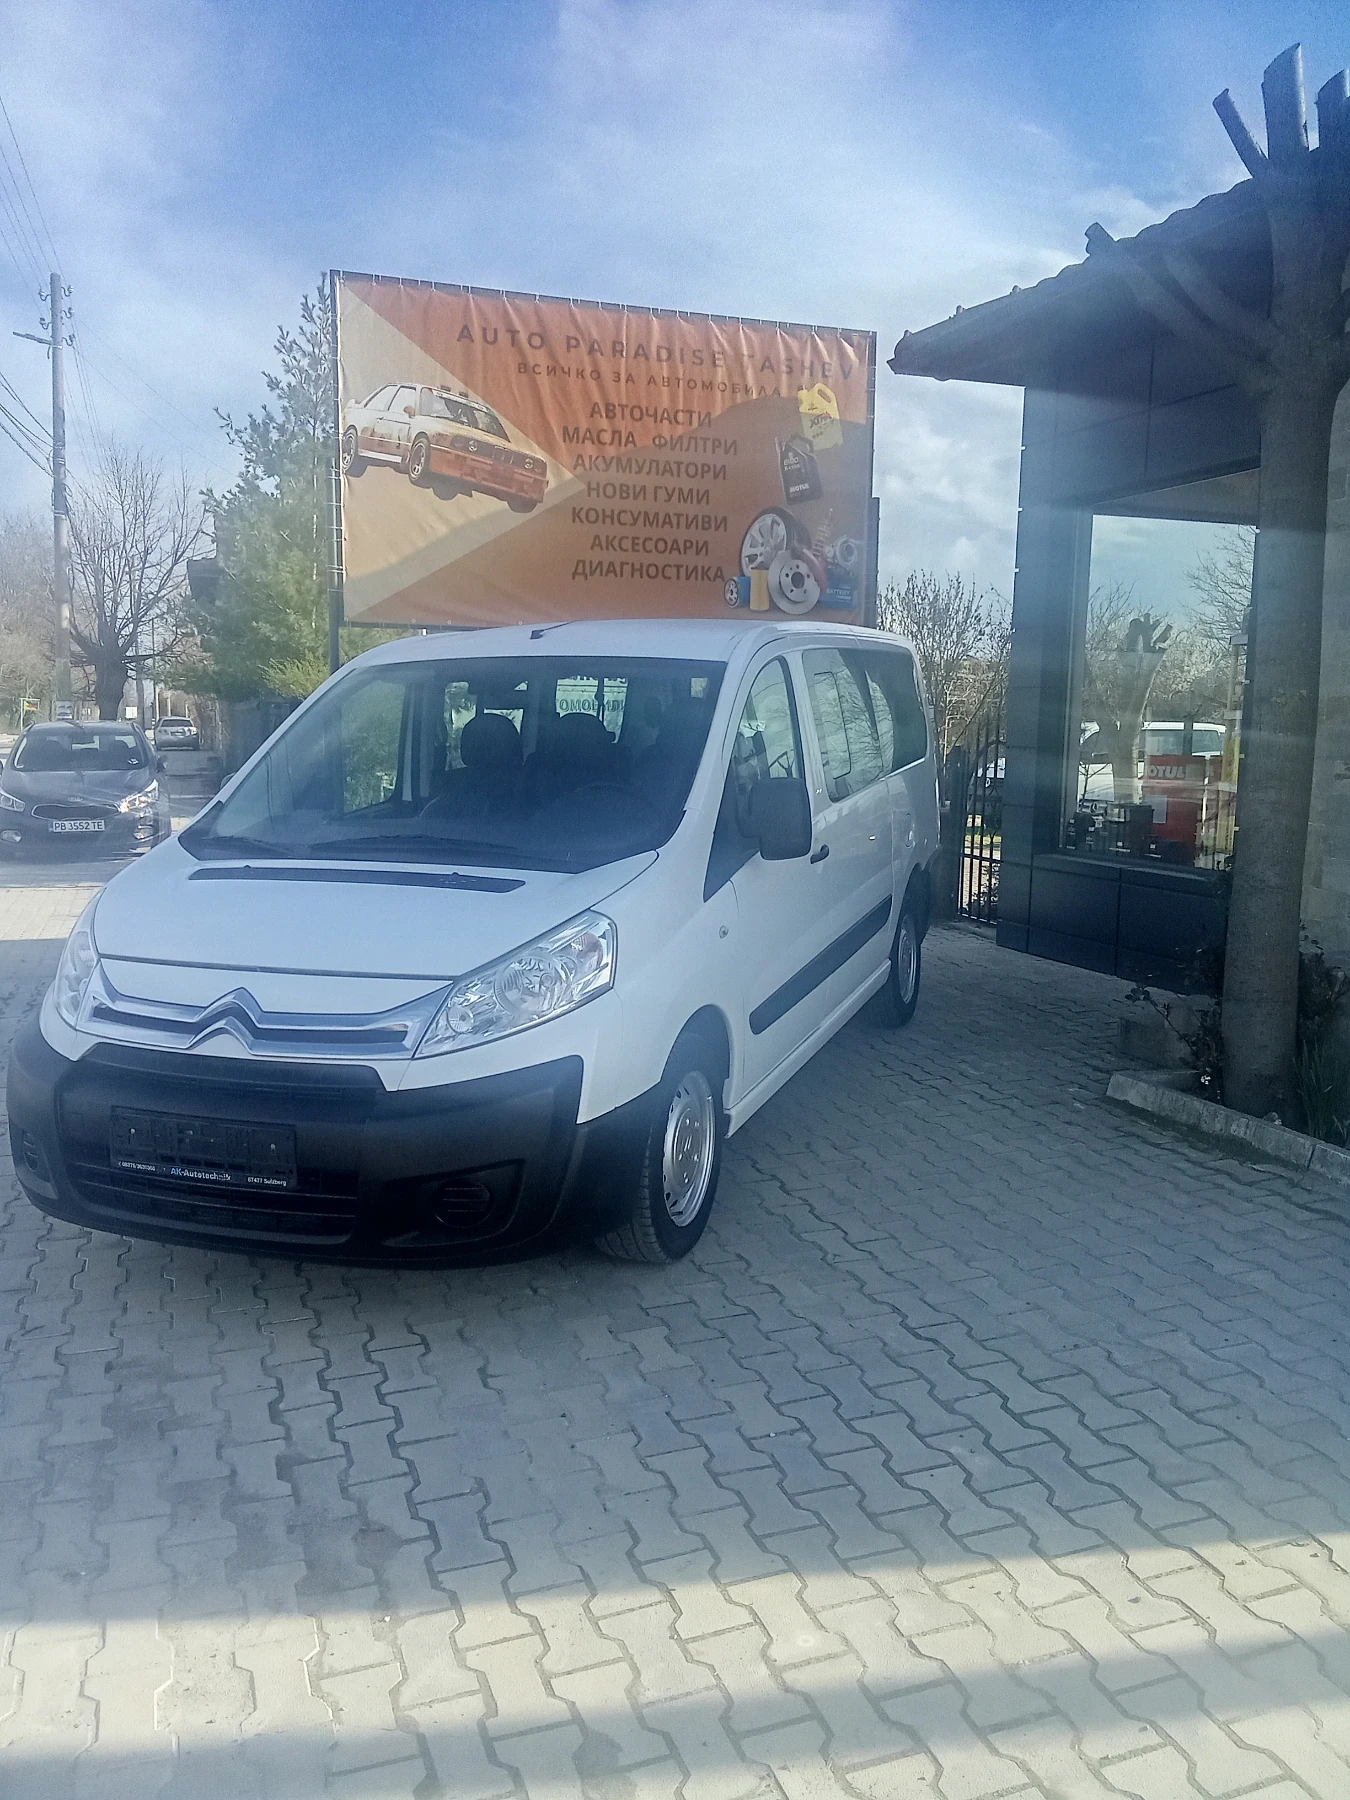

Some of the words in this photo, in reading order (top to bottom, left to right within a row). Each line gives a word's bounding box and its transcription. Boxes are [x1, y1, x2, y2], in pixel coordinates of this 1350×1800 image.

[457, 324, 545, 350] AUTO
[566, 335, 725, 368] PARADISE
[517, 362, 601, 382] ВСИЧКО
[612, 371, 636, 384] ЗА
[647, 375, 782, 397] АВТОМОБИЛА
[589, 401, 713, 428] АВТОЧАСТИ
[562, 425, 638, 448] МАСЛА
[652, 433, 738, 456] ФИЛТРИ
[573, 453, 727, 481] АКУМУЛАТОРИ
[586, 481, 647, 501] НОВИ
[653, 485, 710, 505] ГУМИ
[789, 483, 810, 493] MOTUL
[571, 506, 728, 532] КОНСУМАТИВИ
[590, 534, 709, 556] АКСЕСОАРИ
[571, 559, 725, 583] ДИАГНОСТИКА
[1146, 765, 1185, 778] OTUL
[54, 822, 66, 831] PB
[68, 821, 90, 830] 3552
[91, 821, 103, 830] TE
